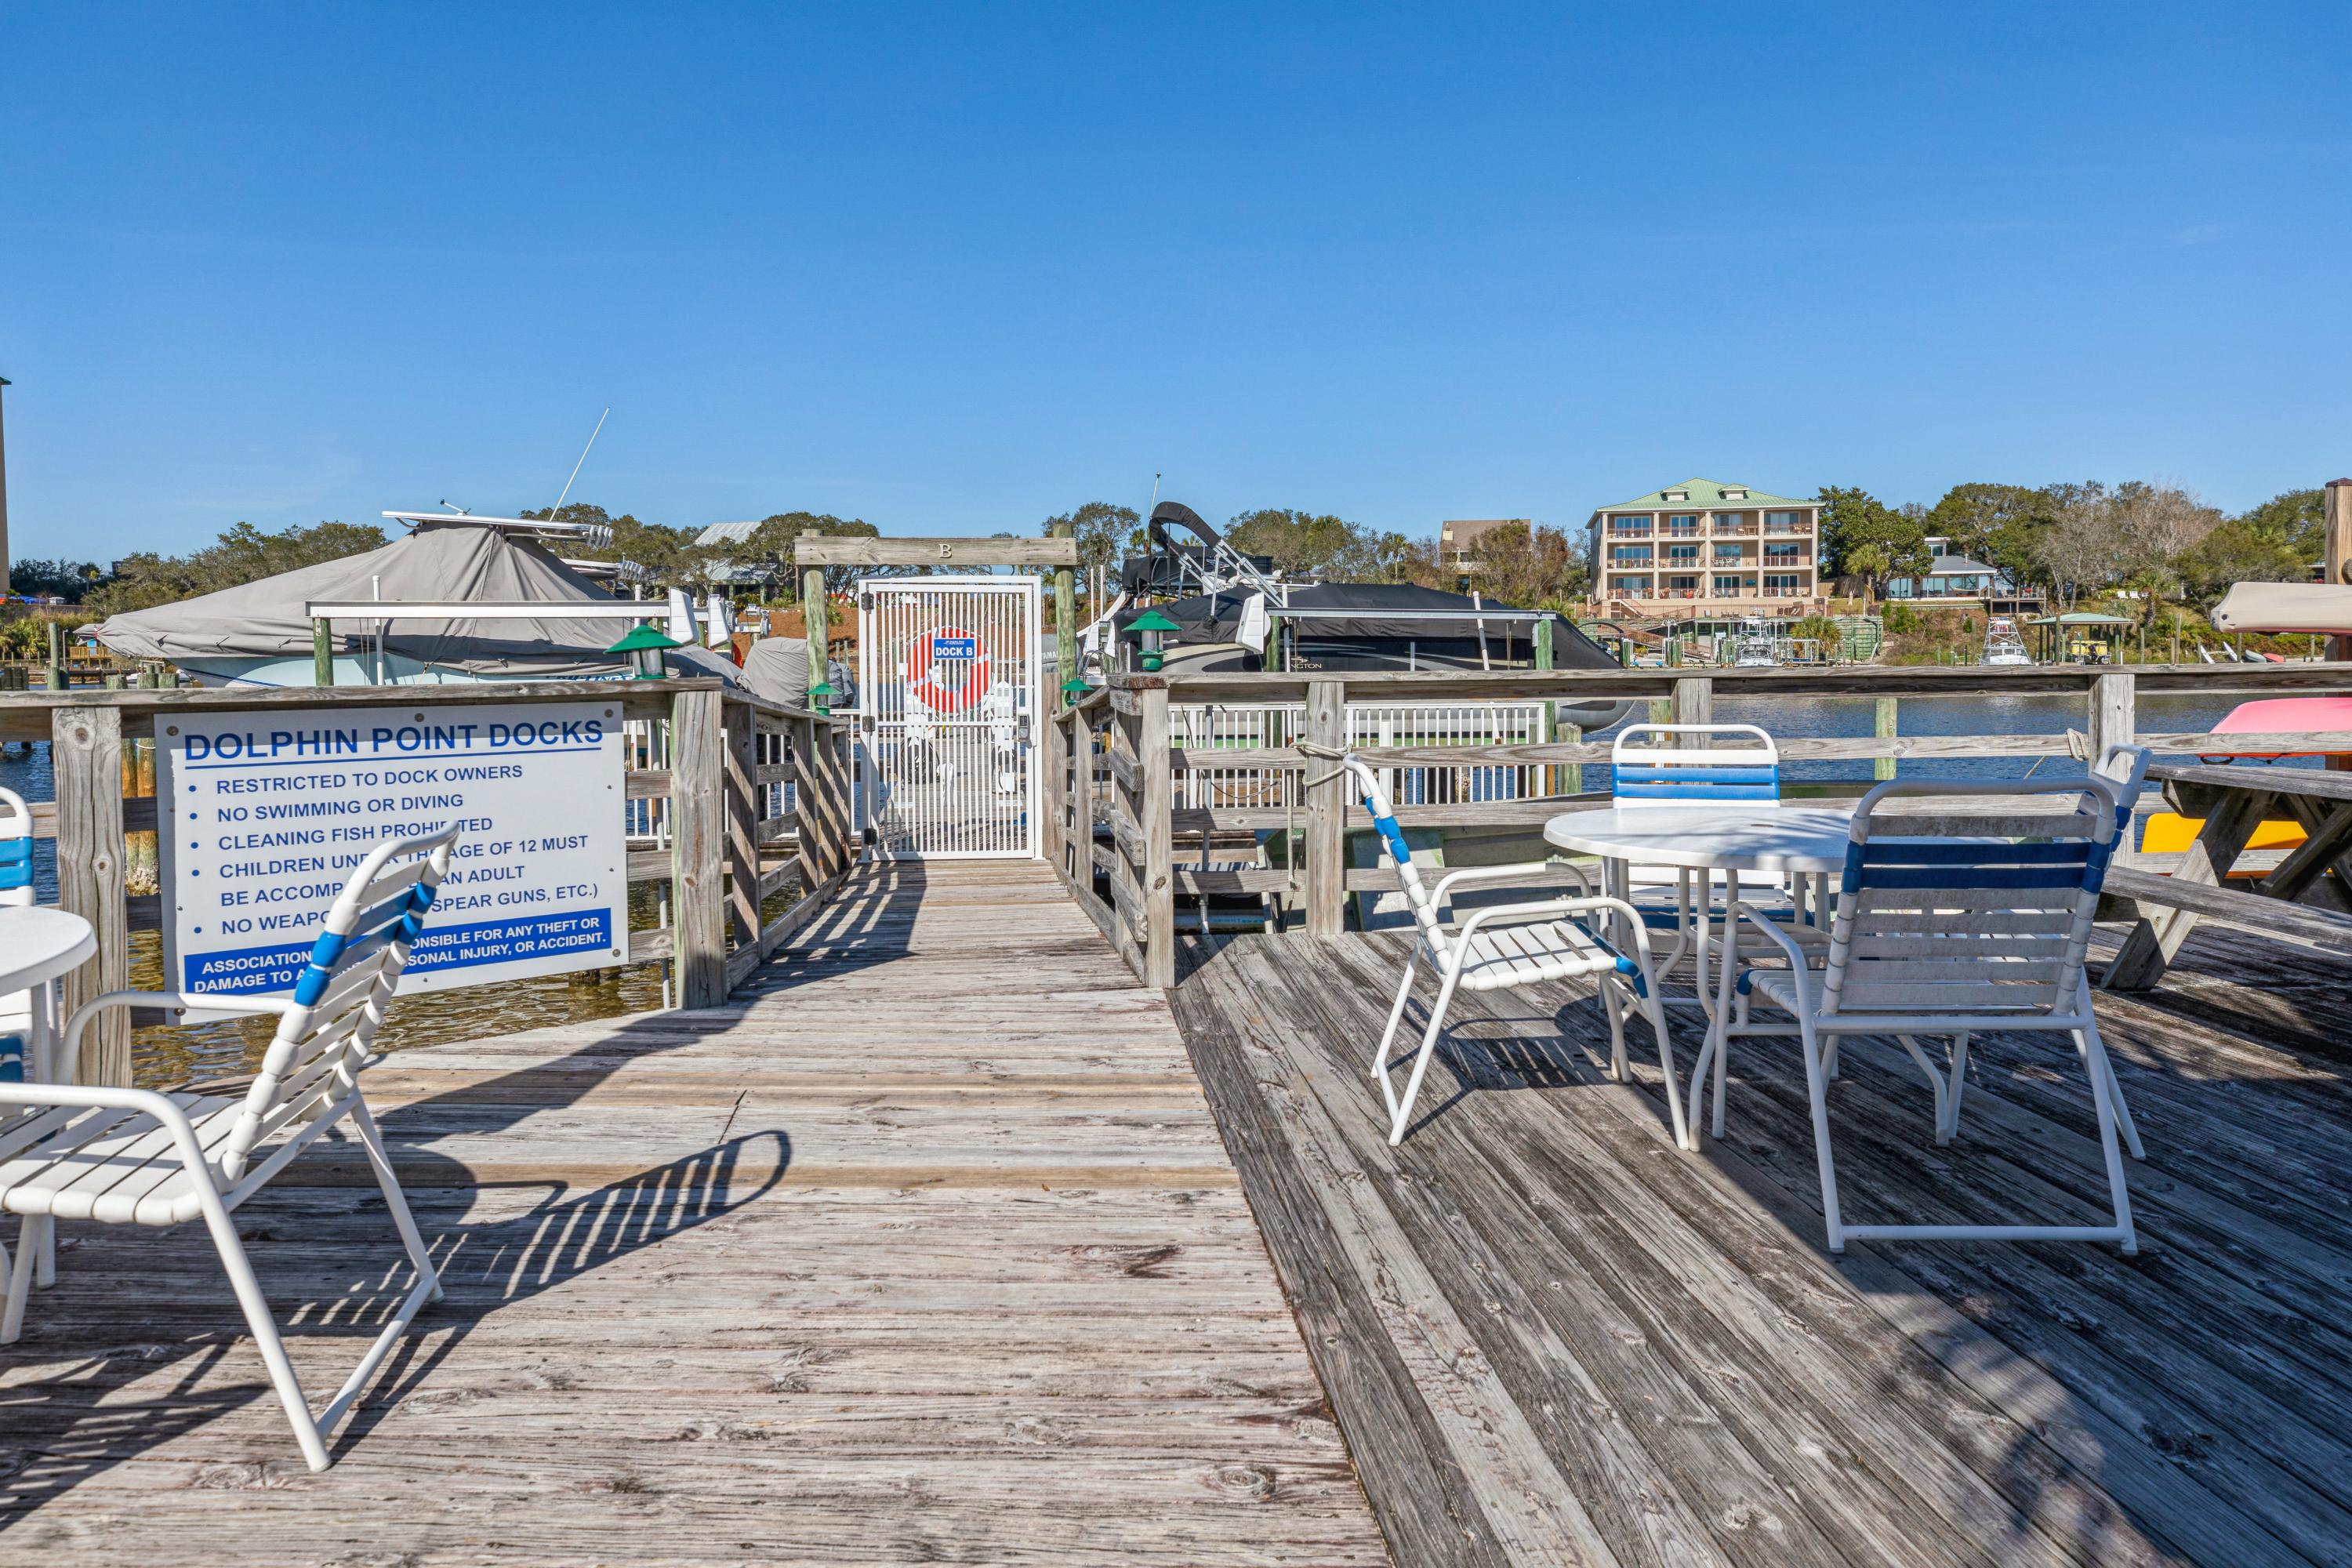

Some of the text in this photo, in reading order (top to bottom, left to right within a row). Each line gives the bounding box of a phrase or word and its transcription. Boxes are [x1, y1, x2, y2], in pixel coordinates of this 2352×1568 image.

[938, 543, 952, 558] B
[935, 647, 974, 656] DOCK B
[184, 720, 603, 760] DOLPHIN POINT DOCKS
[216, 764, 523, 794] RESTRICTED TO DOCK OWNERS
[217, 793, 463, 822] NO SWIMMING OR DIVING
[219, 818, 493, 850] CLEANING FISH PROHITED
[220, 857, 325, 879] CHILDREN
[489, 841, 514, 855] OF
[519, 840, 537, 852] 12
[542, 835, 588, 851] MUST
[221, 891, 249, 906] BE
[255, 882, 343, 903] ACCOMP
[467, 866, 525, 883] ADULT
[222, 919, 252, 935] NO
[431, 894, 492, 912] SPEAR
[497, 888, 551, 905] GUNS,
[556, 883, 598, 899] ETC.)
[194, 973, 267, 993] DAMAGE
[270, 970, 292, 984] TO
[407, 950, 457, 966] SONAL
[460, 942, 512, 960] INJURY,
[514, 940, 535, 954] OR
[538, 931, 606, 949] ACCIDENT.
[201, 916, 600, 975] ASSOCIATION ONSIBLE FOR ANY THEFT OR
